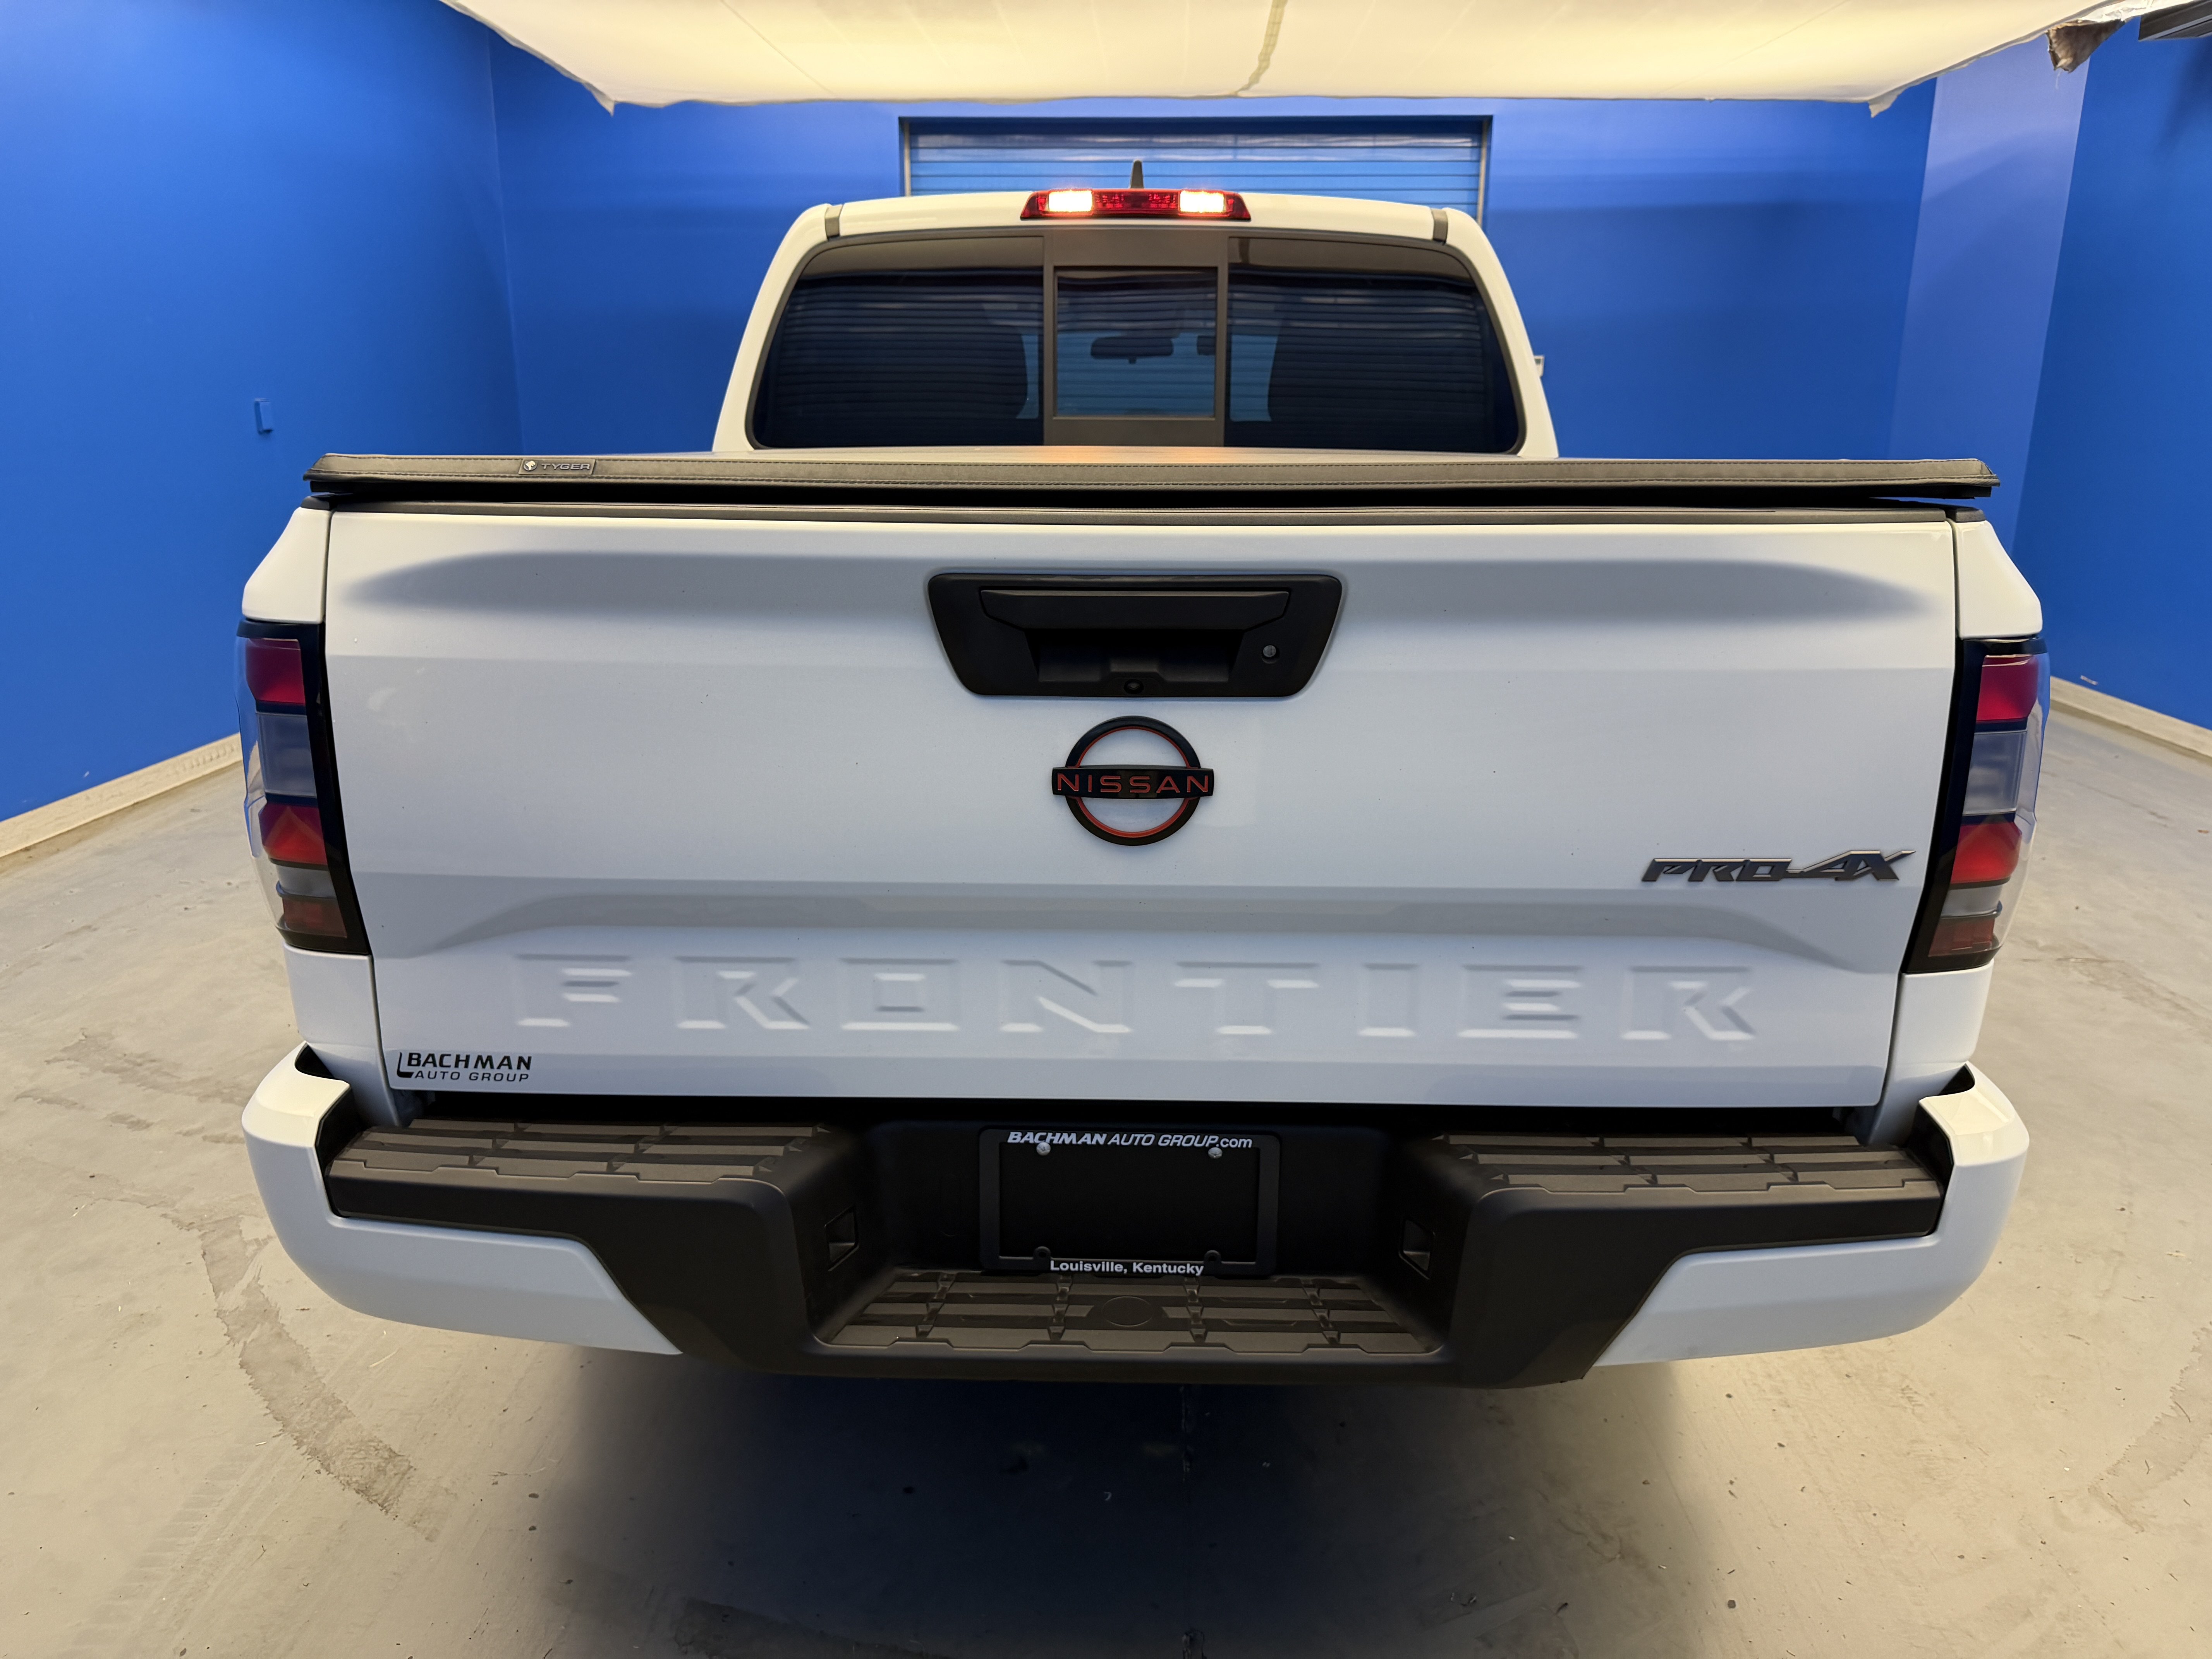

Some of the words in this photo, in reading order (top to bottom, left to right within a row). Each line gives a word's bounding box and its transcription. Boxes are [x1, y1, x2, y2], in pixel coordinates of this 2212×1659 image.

[1057, 773, 1209, 793] NISSAN
[1641, 850, 1917, 882] PRO-4X
[514, 954, 1757, 1041] FRONTIER
[407, 1053, 532, 1070] BACHMAN
[414, 1071, 460, 1080] AUTO
[469, 1072, 529, 1082] GROUP
[1007, 1131, 1106, 1145] BACHMAN
[1107, 1133, 1155, 1146] AUTO
[1158, 1134, 1252, 1148] GROUP.com
[1050, 1260, 1128, 1274] Louisville,
[1132, 1262, 1204, 1276] Kentucky
